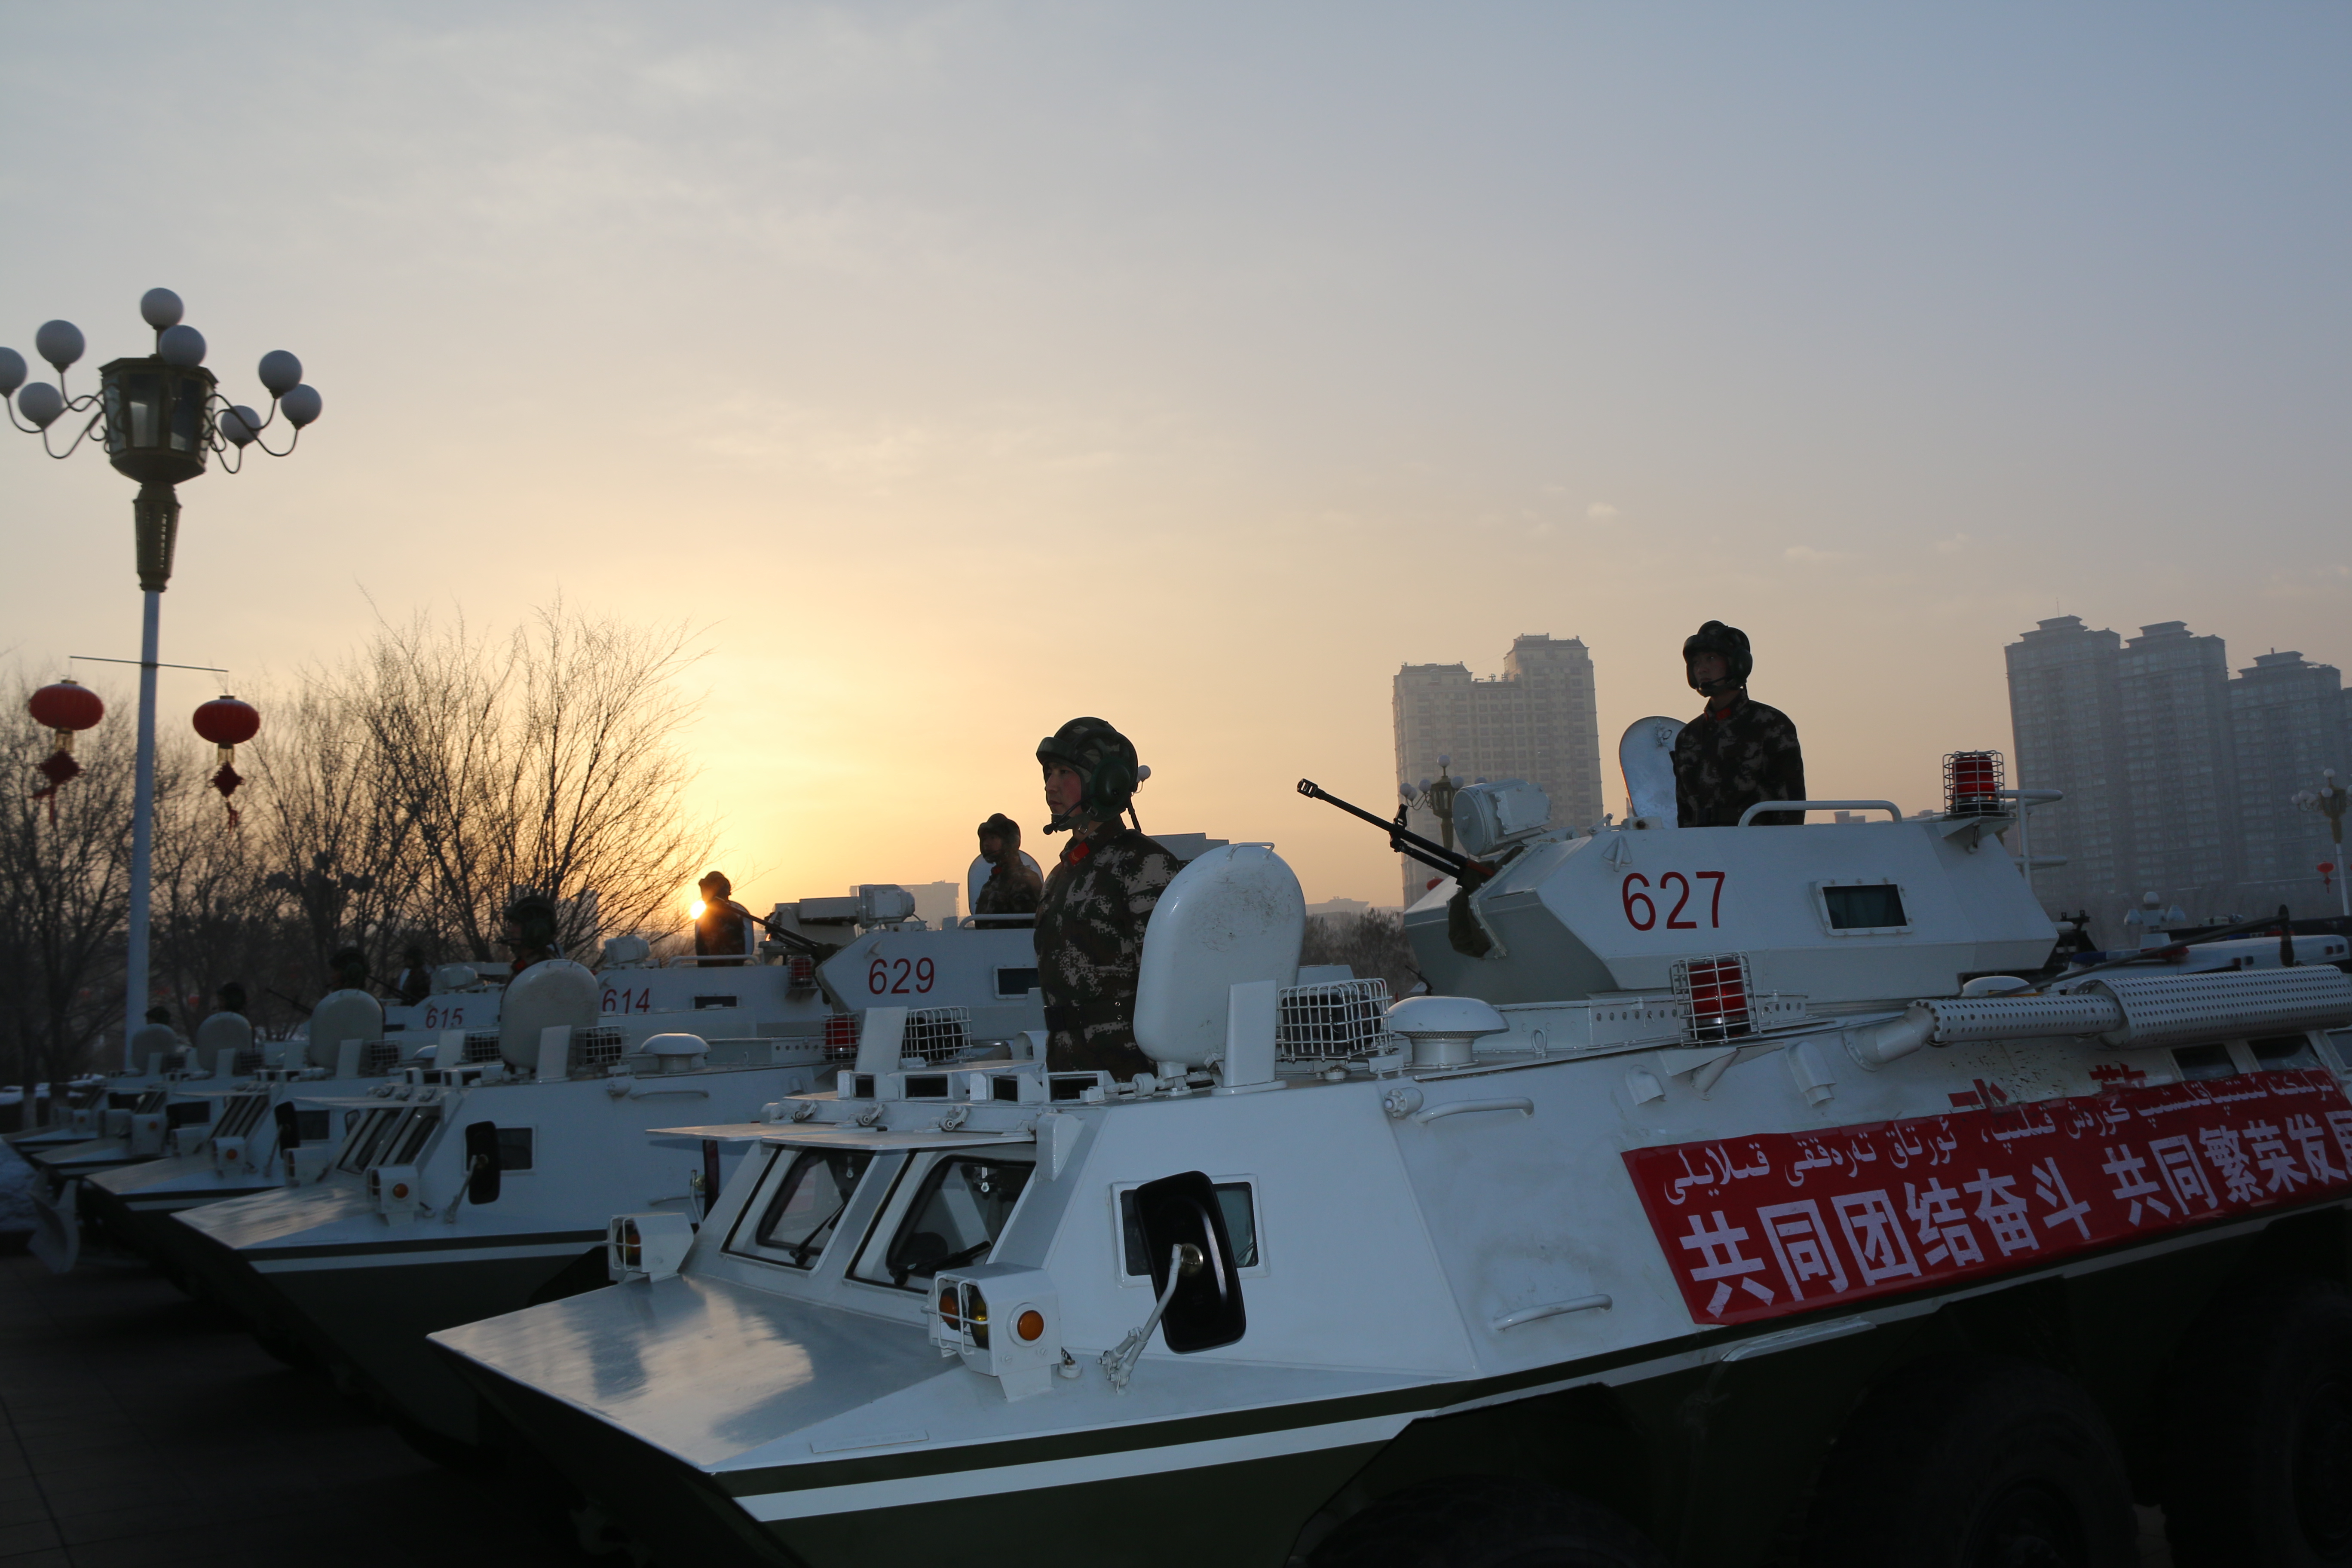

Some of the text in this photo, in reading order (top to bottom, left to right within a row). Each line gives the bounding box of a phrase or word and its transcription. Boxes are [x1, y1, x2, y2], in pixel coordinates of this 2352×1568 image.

[1622, 871, 1725, 931] 627
[868, 957, 935, 995] 629
[425, 1008, 464, 1029] 615
[602, 988, 650, 1014] 614
[1678, 1156, 2092, 1318] 共同团结奋斗
